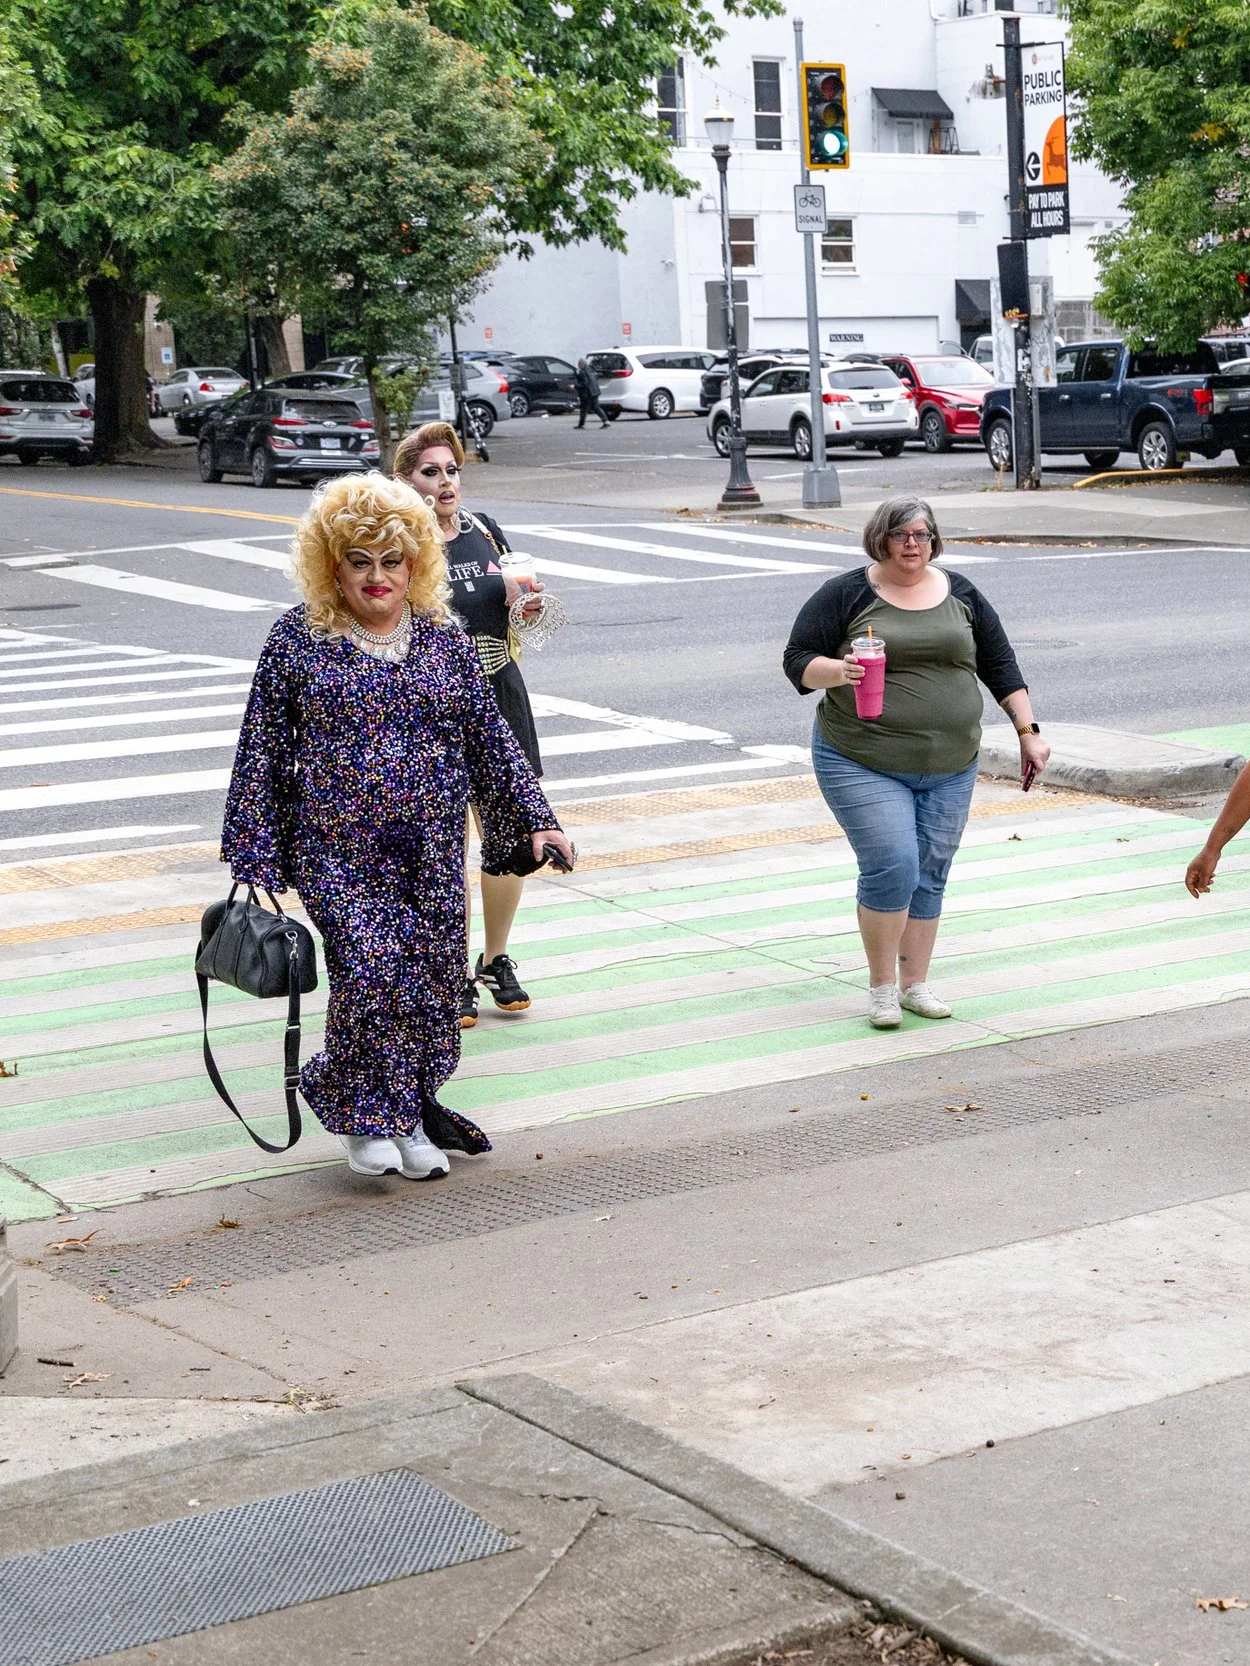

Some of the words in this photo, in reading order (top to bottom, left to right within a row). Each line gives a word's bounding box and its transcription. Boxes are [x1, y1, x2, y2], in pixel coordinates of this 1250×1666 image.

[1024, 70, 1062, 90] PUBLIC
[1024, 89, 1063, 106] PARKING
[1028, 193, 1040, 210] PAY
[1040, 192, 1048, 209] TO
[1048, 191, 1065, 208] PARK
[798, 214, 824, 224] SIGNAL
[1031, 211, 1043, 228] ALL
[1043, 209, 1064, 227] HOURS
[446, 565, 485, 582] LIFE
